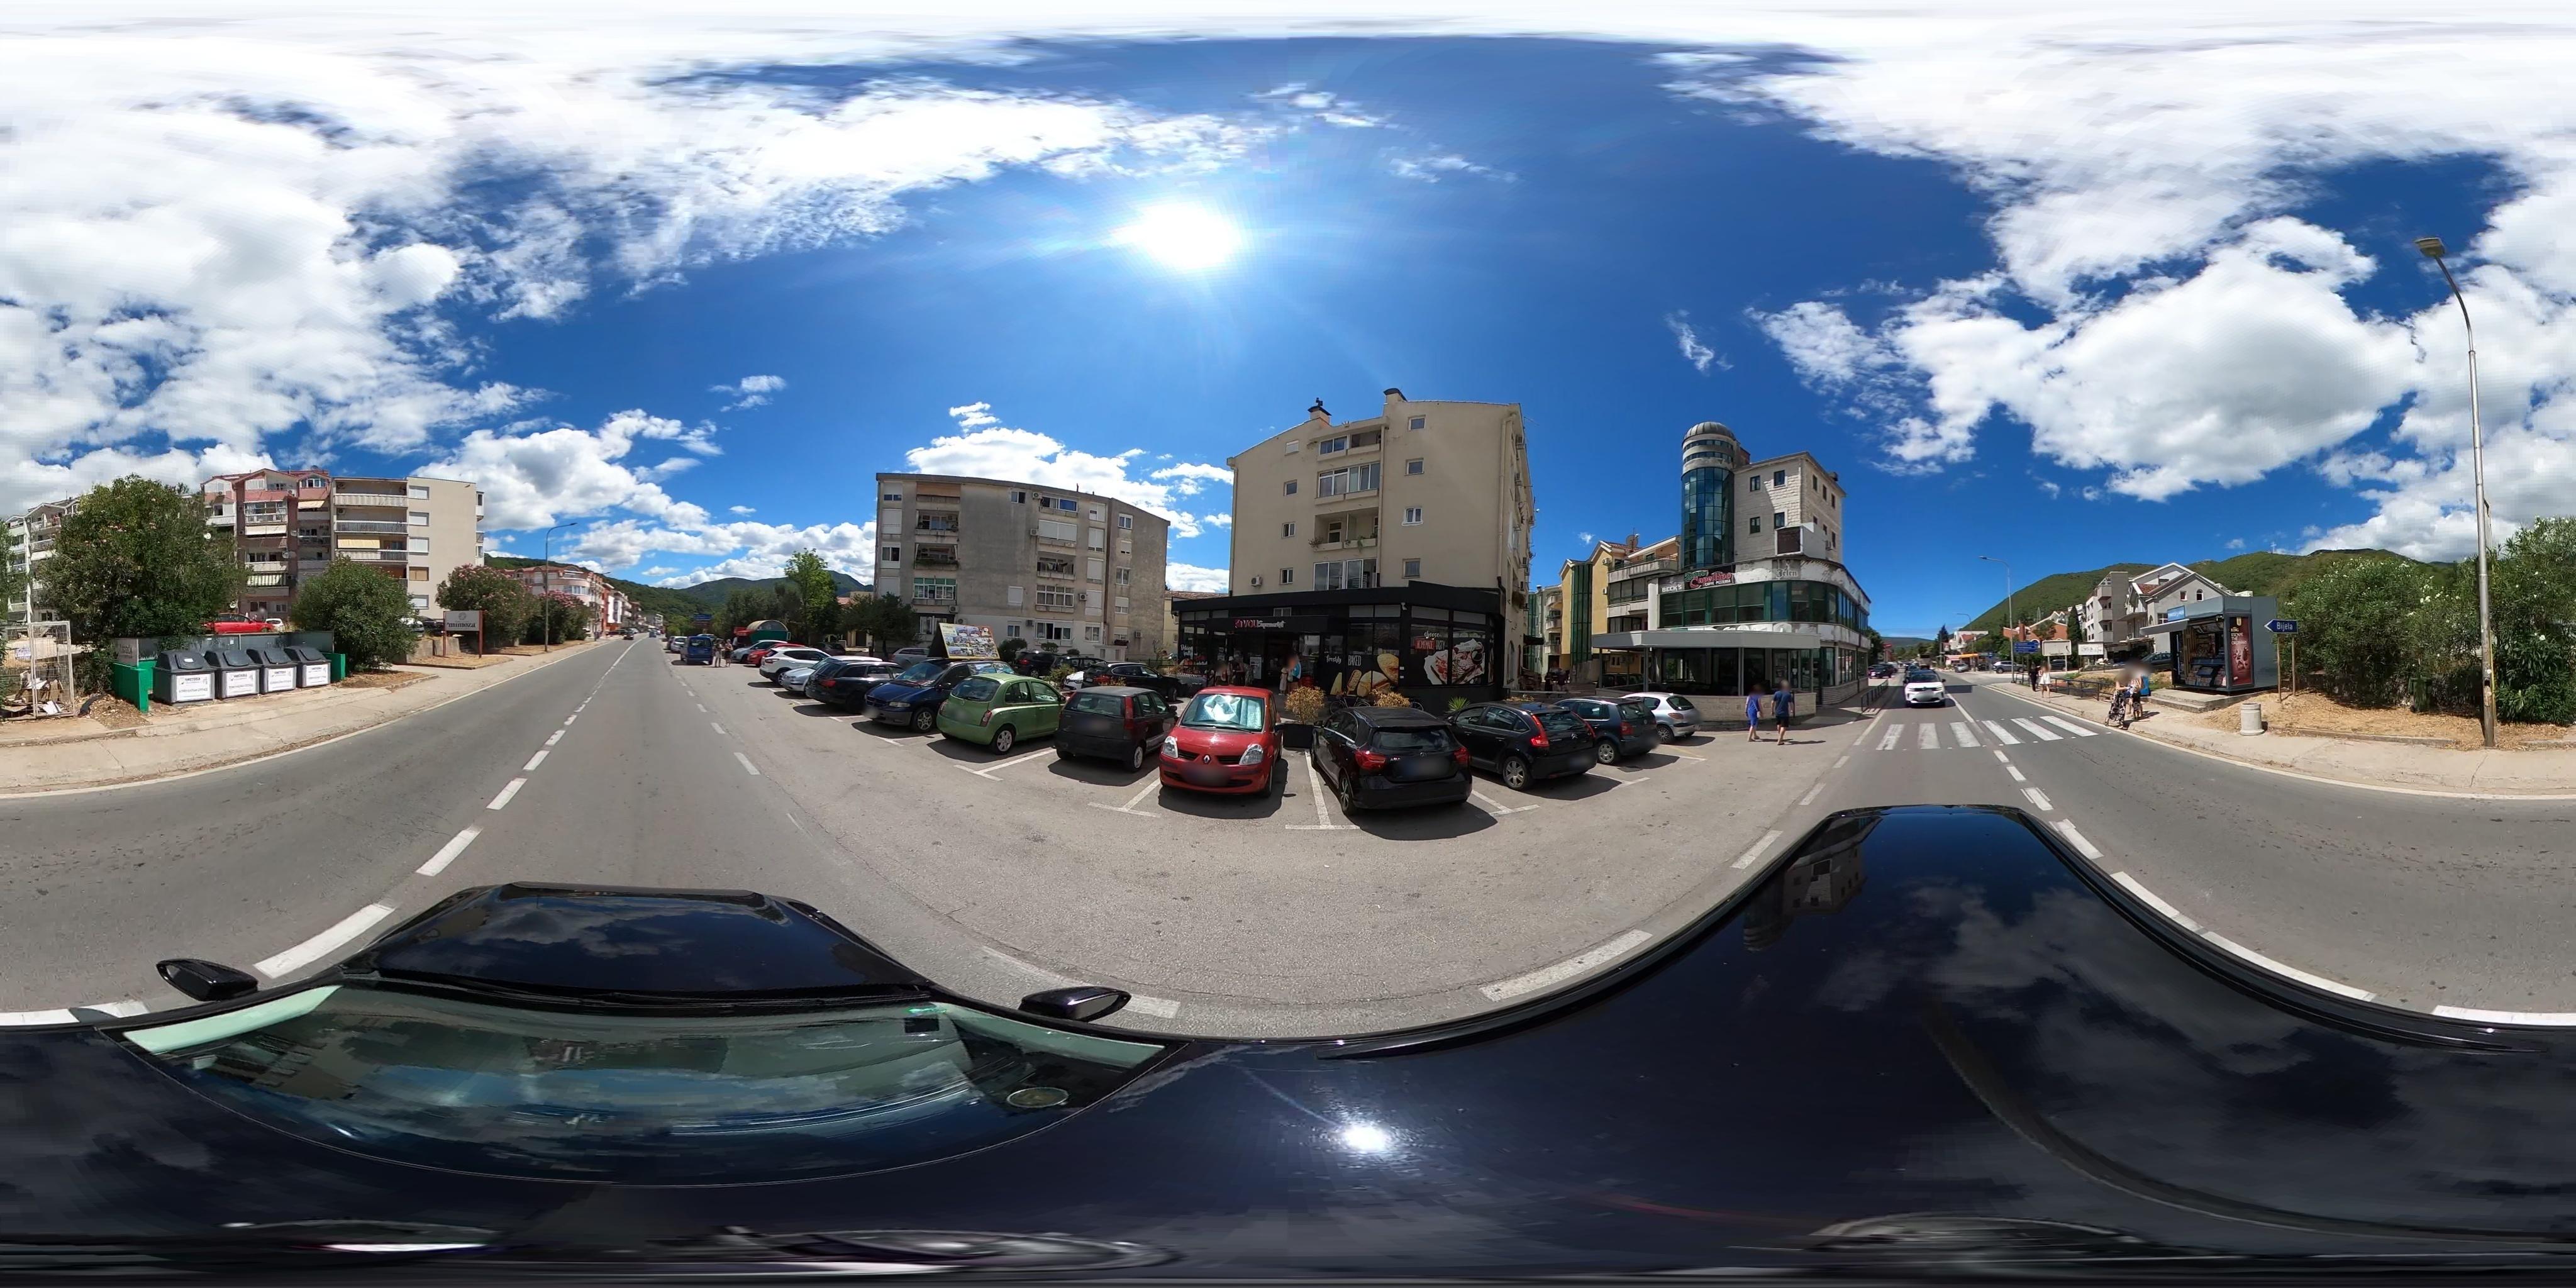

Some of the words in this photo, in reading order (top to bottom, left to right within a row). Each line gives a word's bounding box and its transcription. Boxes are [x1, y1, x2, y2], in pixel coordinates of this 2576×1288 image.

[1776, 568, 1797, 579] Jelen
[1662, 584, 1682, 592] BECK'S
[2277, 621, 2293, 632] Bijela
[1325, 655, 1341, 664] freshly
[1348, 655, 1362, 666] BAKED
